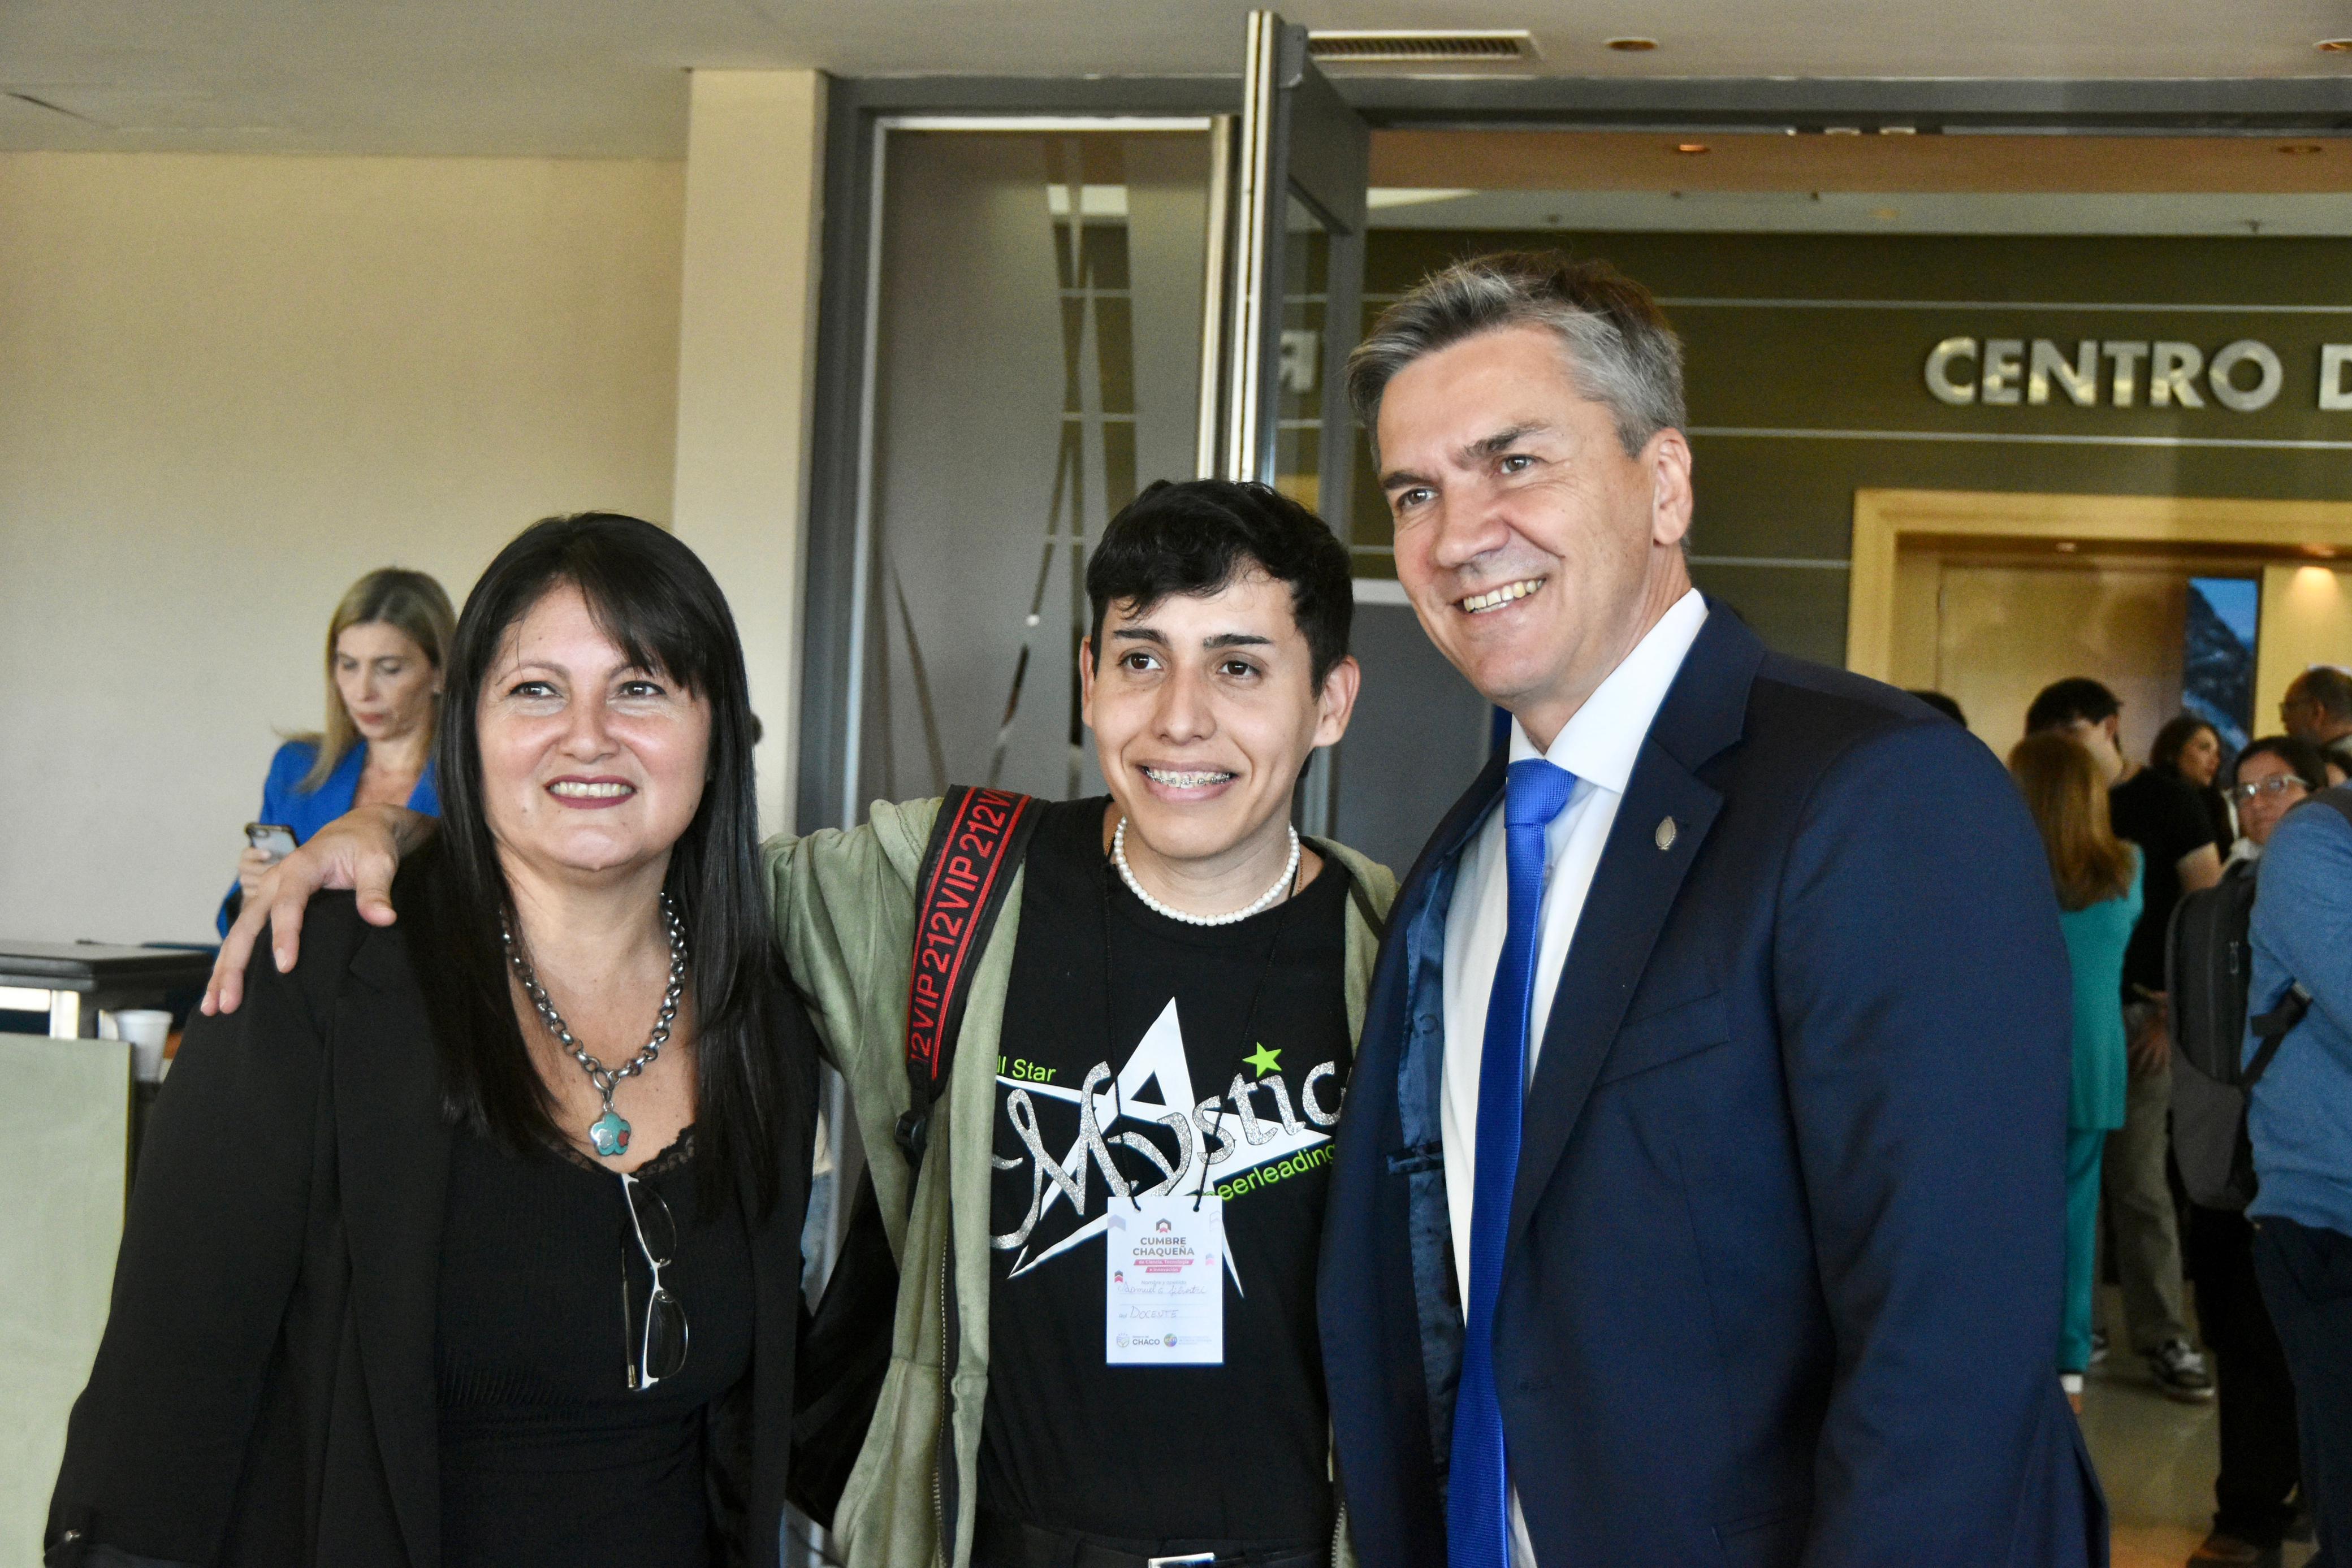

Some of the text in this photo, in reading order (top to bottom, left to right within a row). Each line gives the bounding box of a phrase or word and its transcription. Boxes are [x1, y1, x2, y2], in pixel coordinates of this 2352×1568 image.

[1925, 337, 2283, 412] CENTRO
[911, 788, 1016, 1063] 12VIP 212VIP 212VI
[997, 1055, 1057, 1082] ll Star
[992, 1060, 1346, 1249] Mystic
[1132, 1245, 1195, 1257] CHAQUEÑA
[1140, 1237, 1187, 1245] CUMBRE
[1130, 1305, 1179, 1319] DOCENTE
